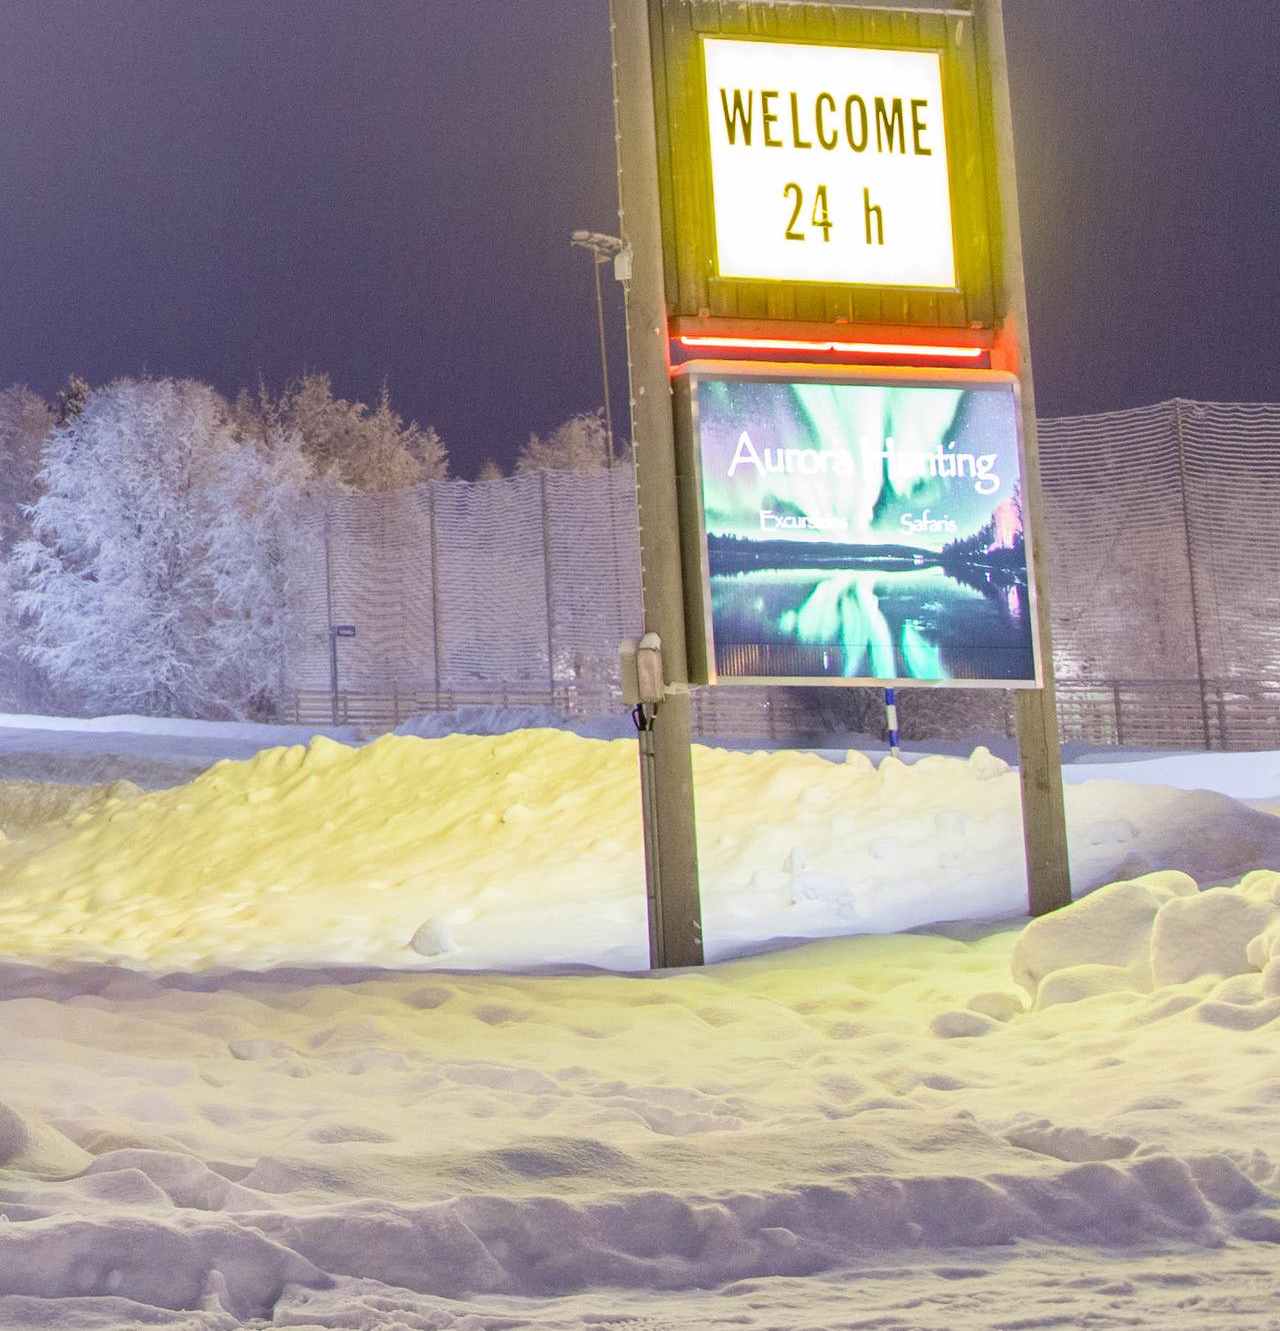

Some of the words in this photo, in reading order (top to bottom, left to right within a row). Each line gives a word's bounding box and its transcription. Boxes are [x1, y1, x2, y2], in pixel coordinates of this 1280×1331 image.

[720, 87, 932, 156] WELCOME
[784, 182, 833, 242] 24
[863, 187, 884, 245] h
[727, 430, 854, 478] Aurora
[861, 436, 1001, 495] Hunting
[899, 509, 957, 535] Safaris
